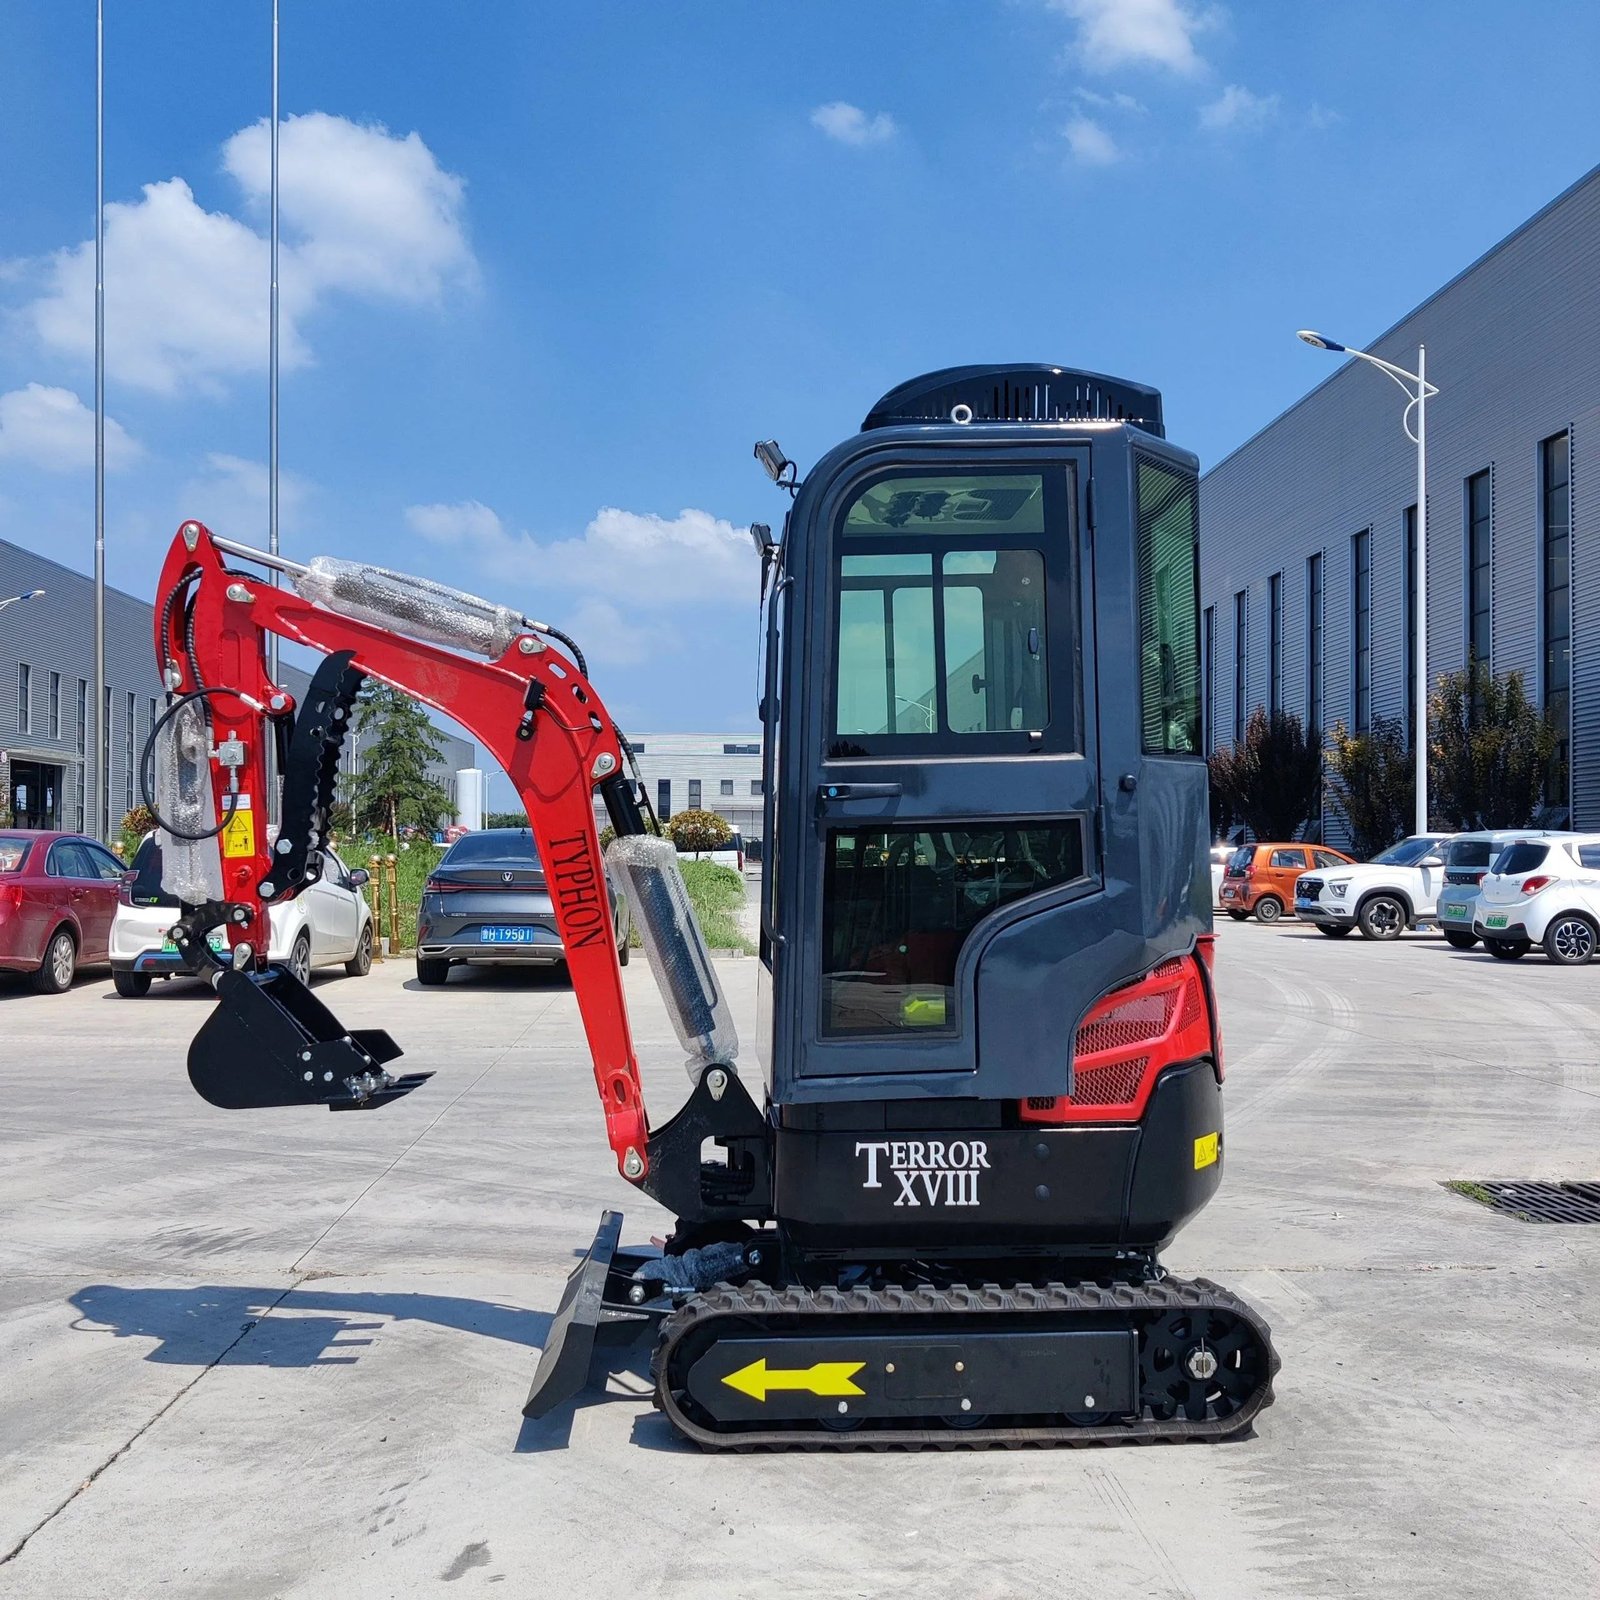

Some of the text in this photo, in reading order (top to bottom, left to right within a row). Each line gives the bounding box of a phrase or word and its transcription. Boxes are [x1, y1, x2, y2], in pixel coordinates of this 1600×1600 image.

[549, 829, 606, 949] TYPHON
[855, 1141, 991, 1187] TERROR
[893, 1170, 980, 1206] XVIII
